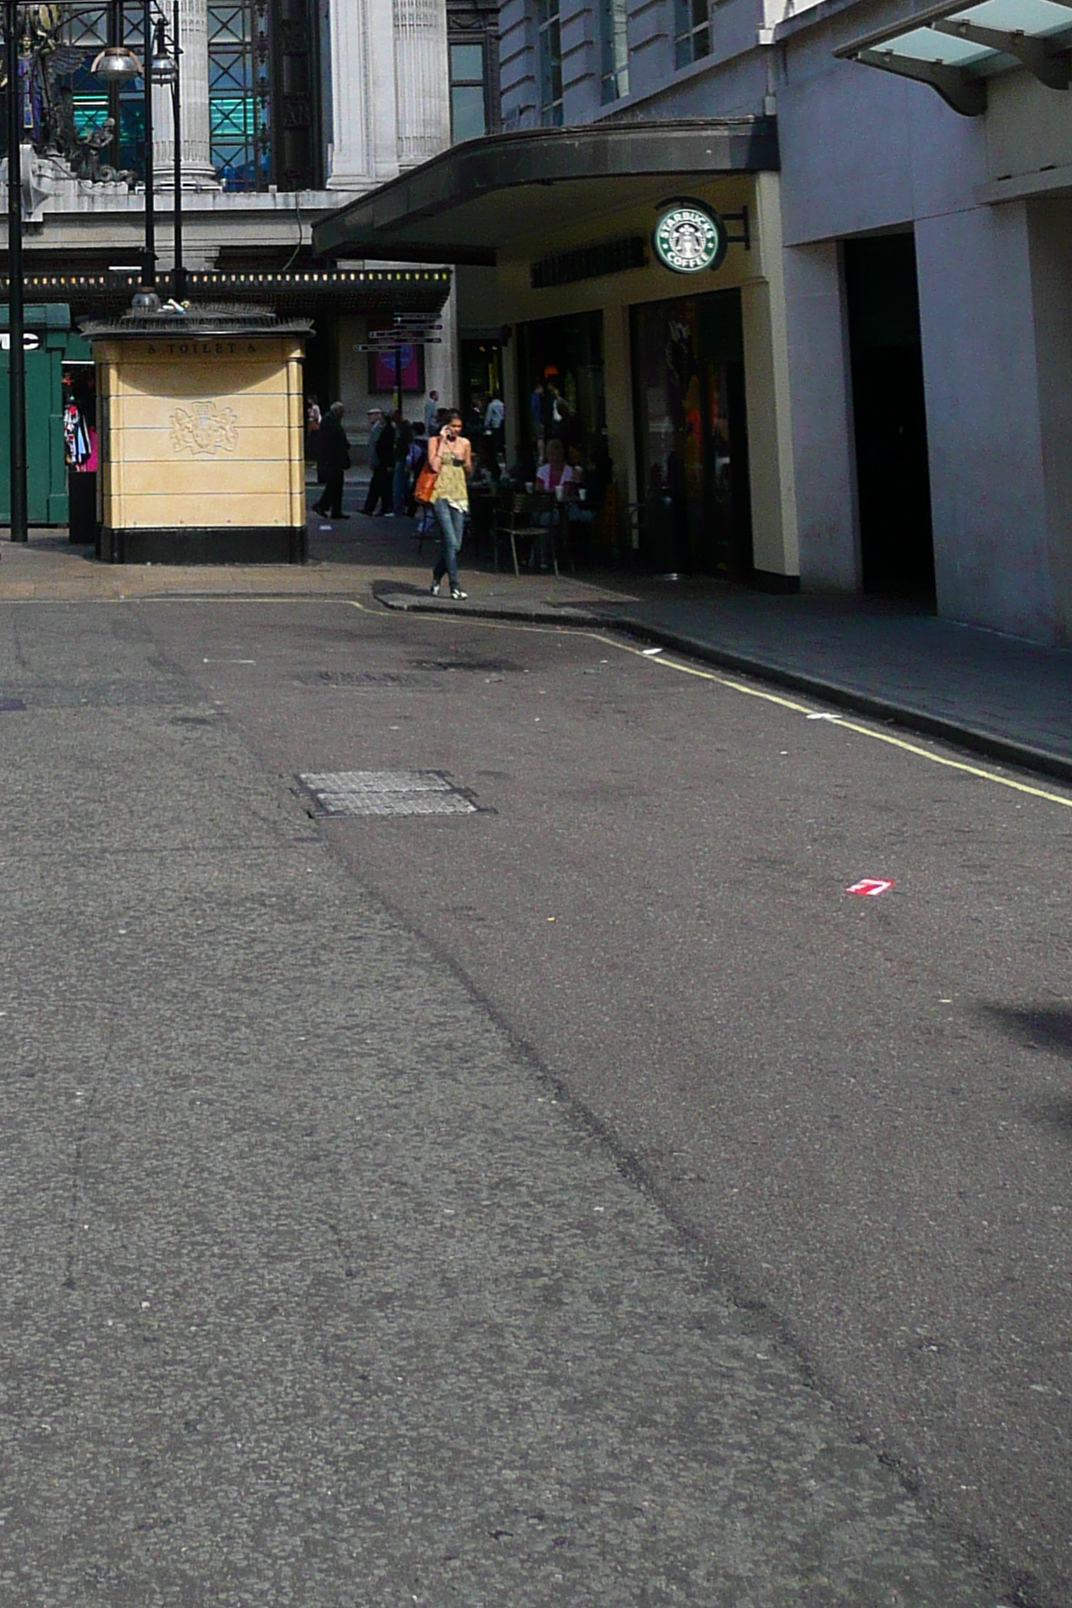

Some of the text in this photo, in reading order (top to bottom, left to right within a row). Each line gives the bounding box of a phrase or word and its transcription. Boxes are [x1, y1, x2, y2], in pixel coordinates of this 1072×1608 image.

[660, 212, 715, 239] STARBUCKS
[667, 251, 710, 268] COFFEE
[167, 343, 236, 354] TOILET
